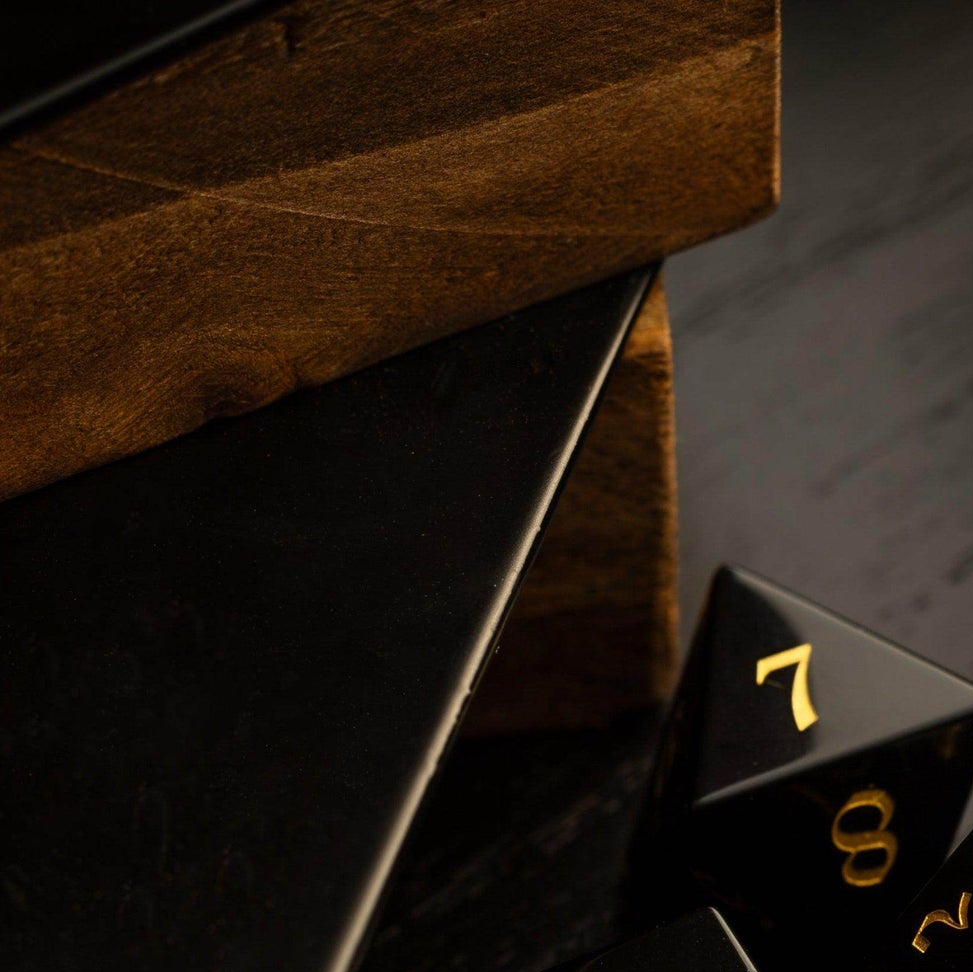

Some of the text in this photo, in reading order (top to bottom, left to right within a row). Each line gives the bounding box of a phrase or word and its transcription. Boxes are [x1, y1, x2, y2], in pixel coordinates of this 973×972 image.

[756, 643, 818, 732] 7
[832, 787, 897, 887] 8
[912, 893, 970, 952] 2
